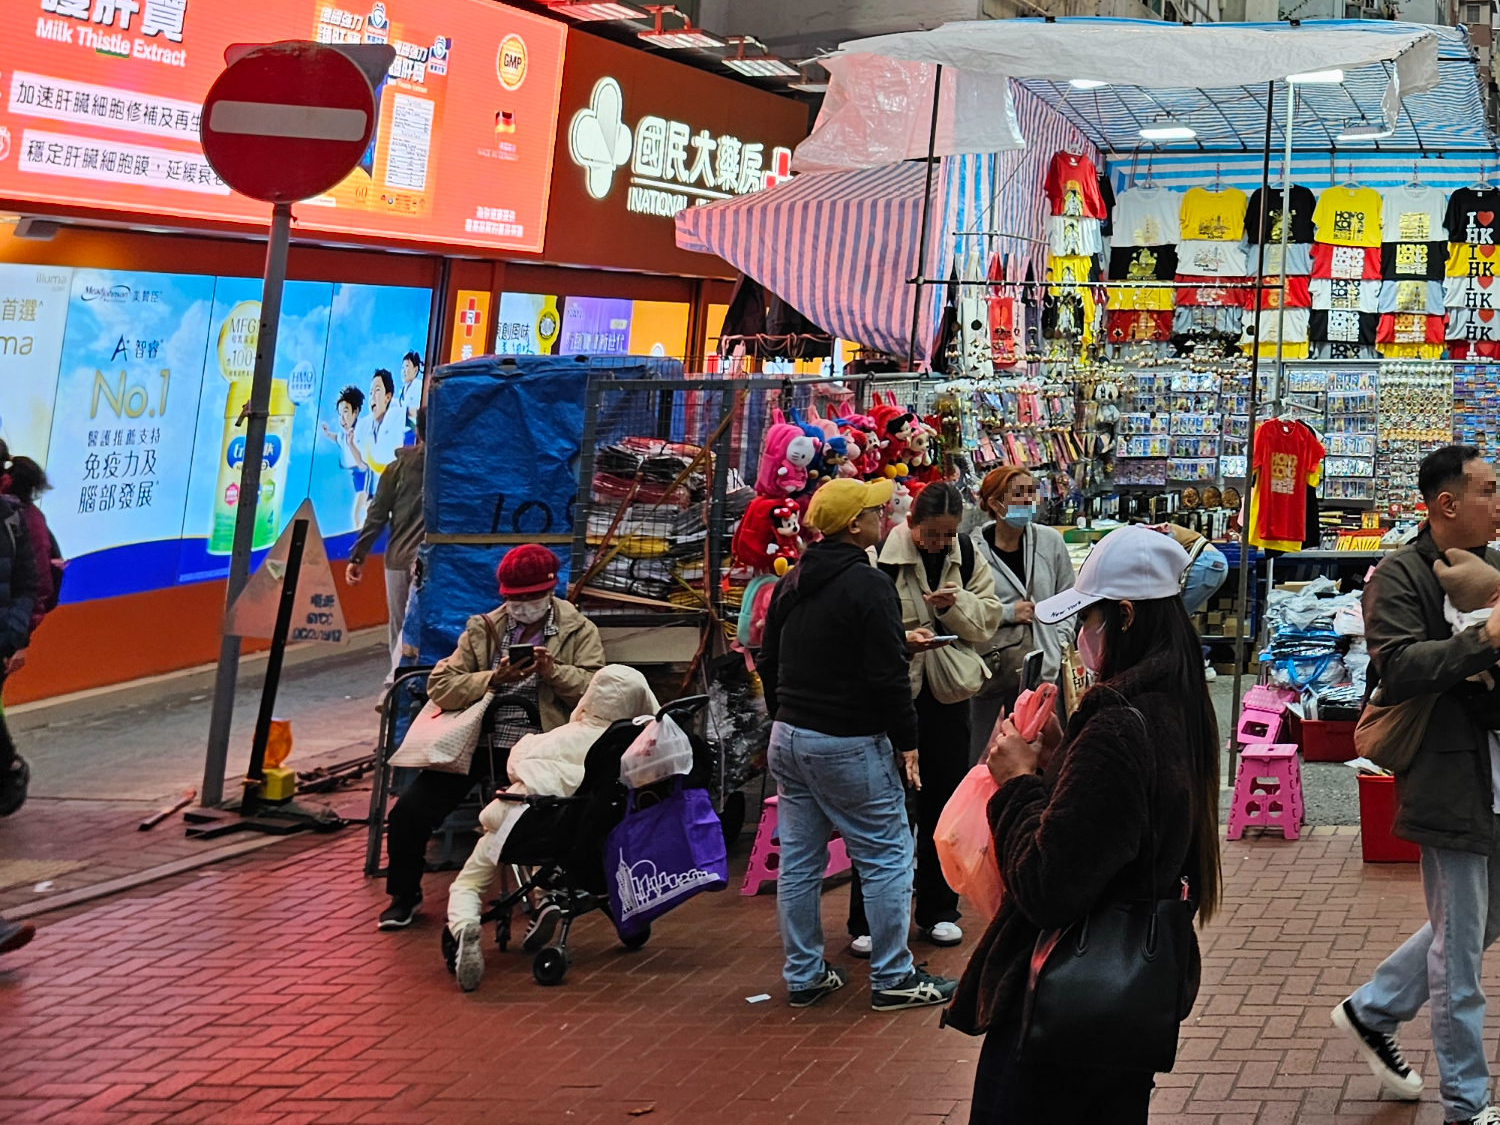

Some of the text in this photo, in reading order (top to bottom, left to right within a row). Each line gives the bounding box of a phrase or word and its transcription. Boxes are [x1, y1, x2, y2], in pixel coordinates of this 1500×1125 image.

[36, 17, 187, 67] Milk Thistle Extract
[503, 53, 522, 69] GMP
[632, 115, 764, 193] 國民大藥房
[1466, 212, 1477, 228] I
[1465, 227, 1494, 244] HK
[1468, 245, 1478, 260] I
[1467, 262, 1494, 276] HK
[36, 273, 67, 285] illuma
[1466, 276, 1475, 291] I
[1465, 293, 1492, 308] HK
[1466, 309, 1476, 324] I
[1465, 326, 1493, 341] HK
[90, 369, 171, 420] No.1
[83, 449, 157, 481] 免疫力及
